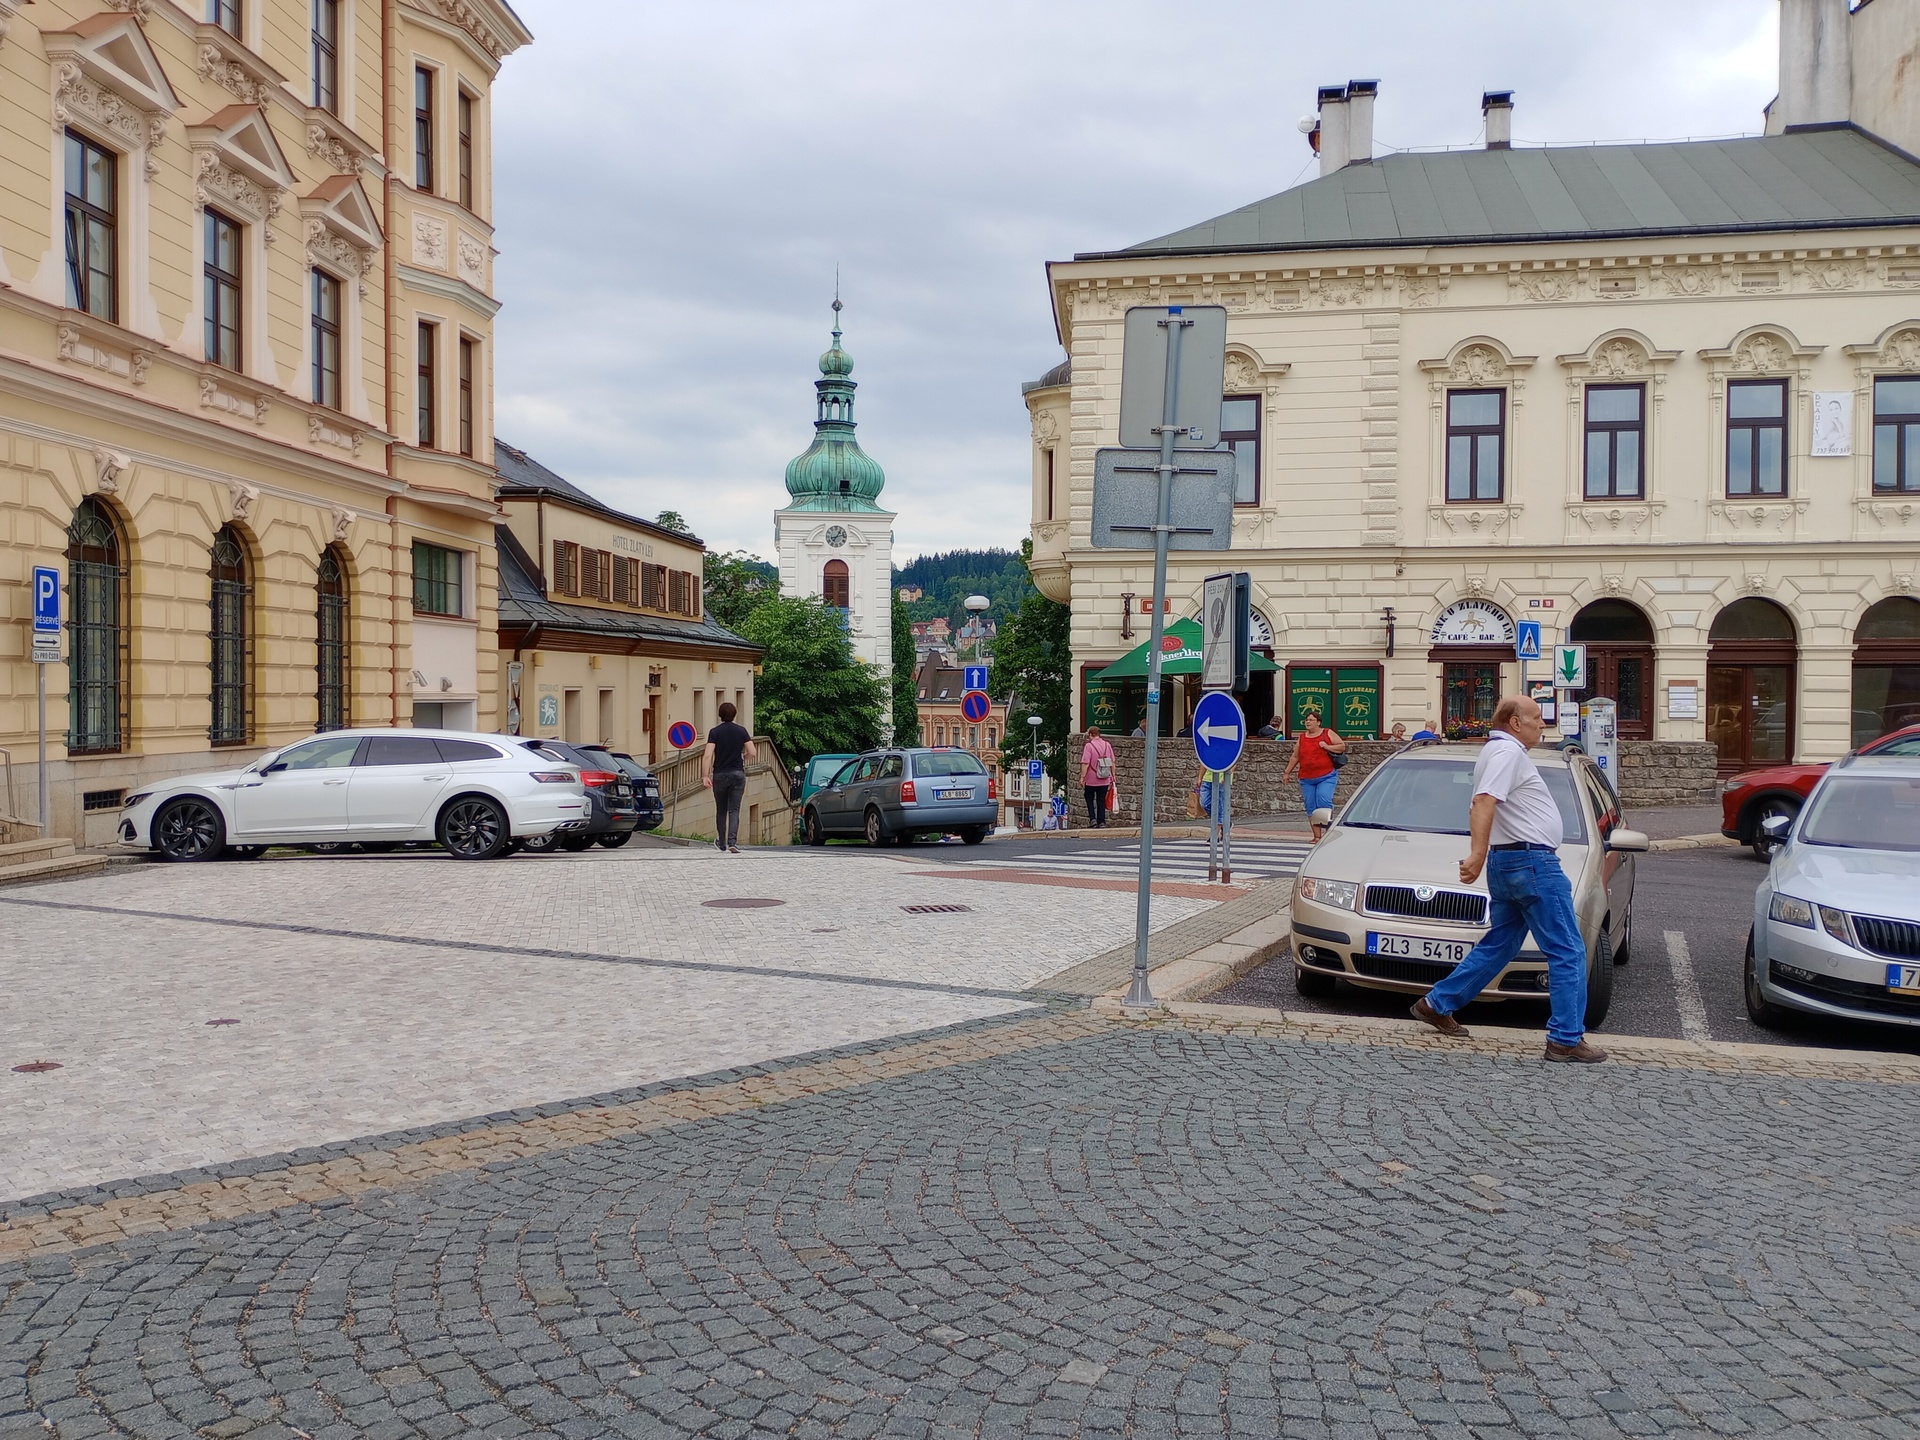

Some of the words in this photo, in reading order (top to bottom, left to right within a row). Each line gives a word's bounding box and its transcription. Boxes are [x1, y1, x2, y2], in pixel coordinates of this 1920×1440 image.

[613, 534, 629, 551] HOTEL
[39, 575, 54, 612] P
[1446, 607, 1455, 616] U
[1458, 601, 1505, 621] ZLATÉHO
[1502, 622, 1514, 641] LVA
[1258, 622, 1271, 642] LVA
[1447, 632, 1468, 641] CAFÉ
[40, 652, 48, 660] PRO
[1087, 687, 1122, 695] RESTAURANT
[1031, 762, 1039, 773] P
[1381, 937, 1410, 955] 2L3
[1423, 941, 1464, 961] 5418
[1905, 969, 1920, 987] 7
